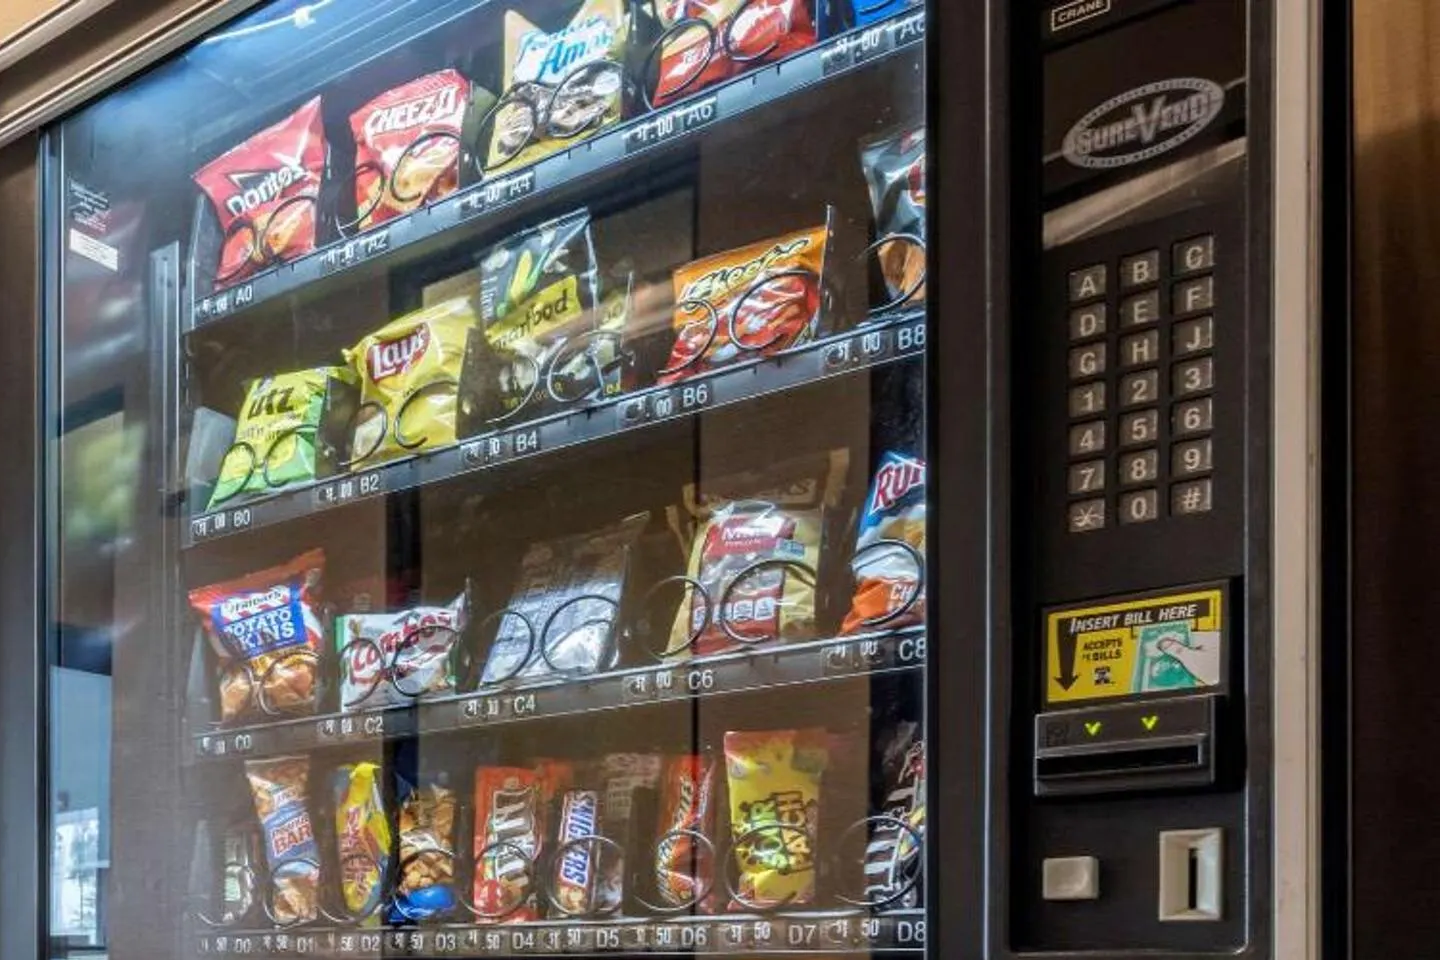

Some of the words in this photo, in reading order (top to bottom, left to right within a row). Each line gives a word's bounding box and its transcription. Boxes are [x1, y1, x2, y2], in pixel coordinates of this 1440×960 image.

[1079, 276, 1096, 297] A
[1133, 260, 1148, 283] B
[1185, 246, 1203, 268] C
[1080, 314, 1095, 336] D
[1133, 301, 1147, 324] E
[1186, 287, 1201, 312] F
[898, 324, 925, 350] B8
[1080, 353, 1095, 376] G
[1133, 339, 1148, 364] H
[1186, 327, 1200, 350] J
[683, 388, 708, 407] B6
[1083, 391, 1094, 409] 1
[1133, 379, 1147, 401] 2
[1185, 368, 1200, 389] 3
[1080, 429, 1094, 450] 4
[1133, 418, 1146, 441] 5
[1184, 408, 1200, 429] 6
[1080, 468, 1094, 490] 7
[1132, 458, 1146, 480] 8
[1185, 448, 1200, 470] 9
[1131, 497, 1147, 519] 0
[1070, 614, 1119, 634] INSERT
[1124, 611, 1153, 627] BILL
[1159, 604, 1198, 621] HERE
[899, 639, 925, 660] C8
[689, 670, 713, 690] C6
[514, 695, 535, 713] C4
[365, 718, 384, 734] C2
[597, 928, 619, 947] D5
[681, 927, 707, 945] D6
[789, 925, 816, 944] D7
[898, 921, 925, 942] D8
